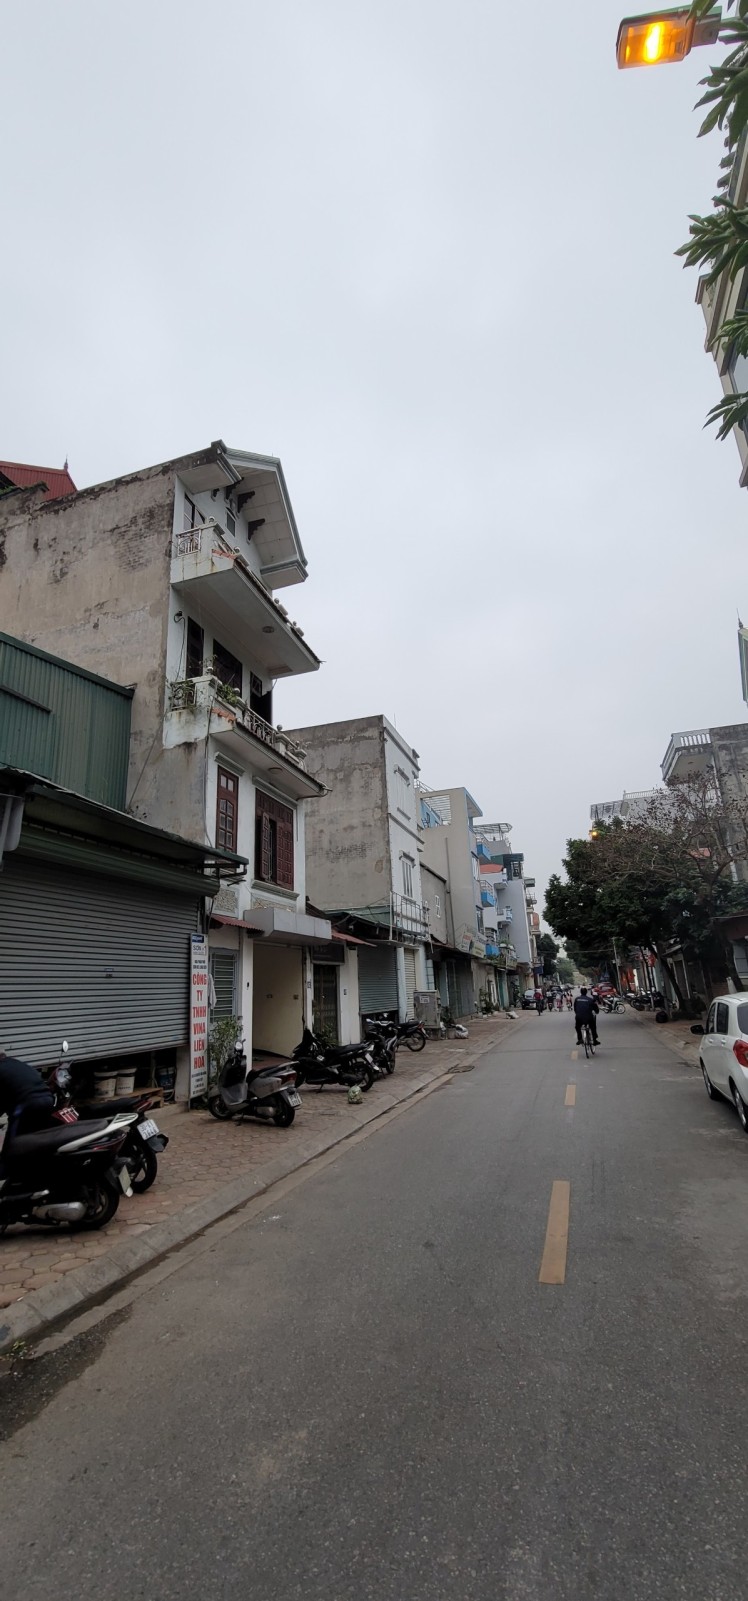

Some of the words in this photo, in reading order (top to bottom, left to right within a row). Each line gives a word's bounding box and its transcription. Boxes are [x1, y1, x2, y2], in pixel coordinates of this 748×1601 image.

[193, 972, 207, 985] CÔNG
[197, 990, 203, 1001] TY
[192, 1006, 206, 1018] TNHH
[193, 1022, 206, 1035] VINA
[194, 1038, 205, 1052] LIÊN
[194, 1056, 205, 1069] HOA
